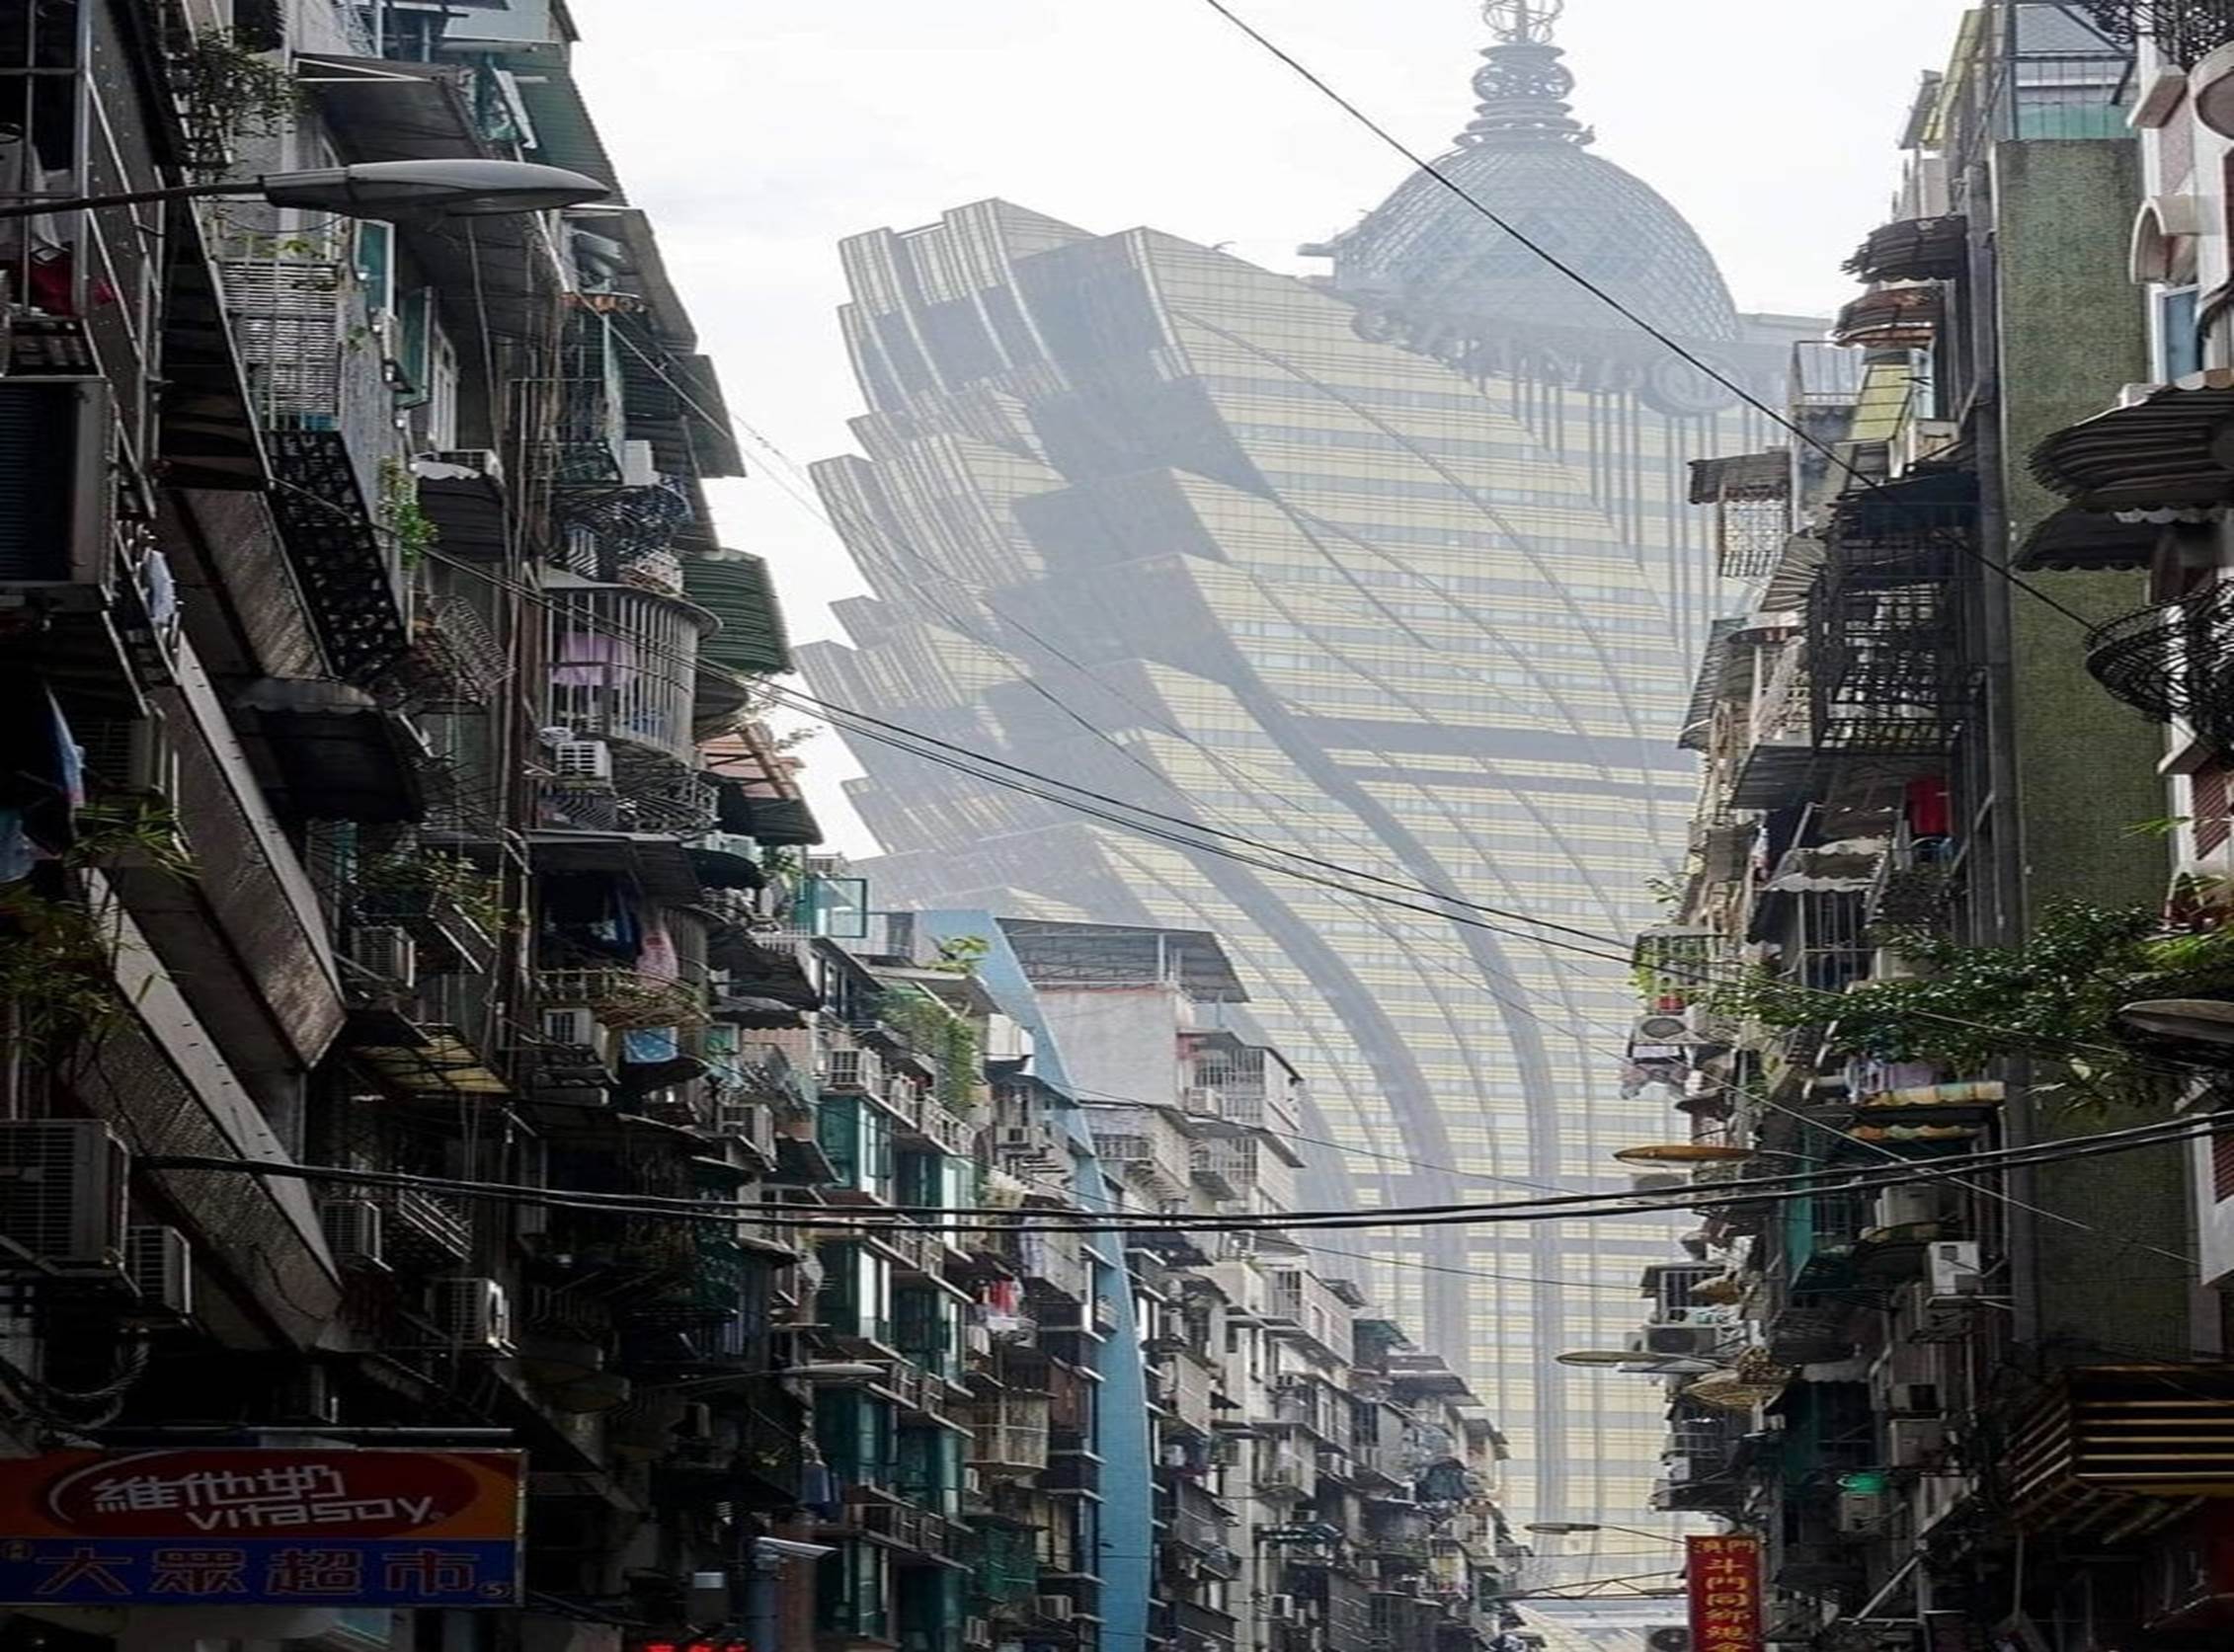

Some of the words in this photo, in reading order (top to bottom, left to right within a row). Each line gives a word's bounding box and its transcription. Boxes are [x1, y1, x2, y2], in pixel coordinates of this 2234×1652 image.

[93, 1464, 346, 1513] 維他奶
[186, 1495, 434, 1531] vitasoy
